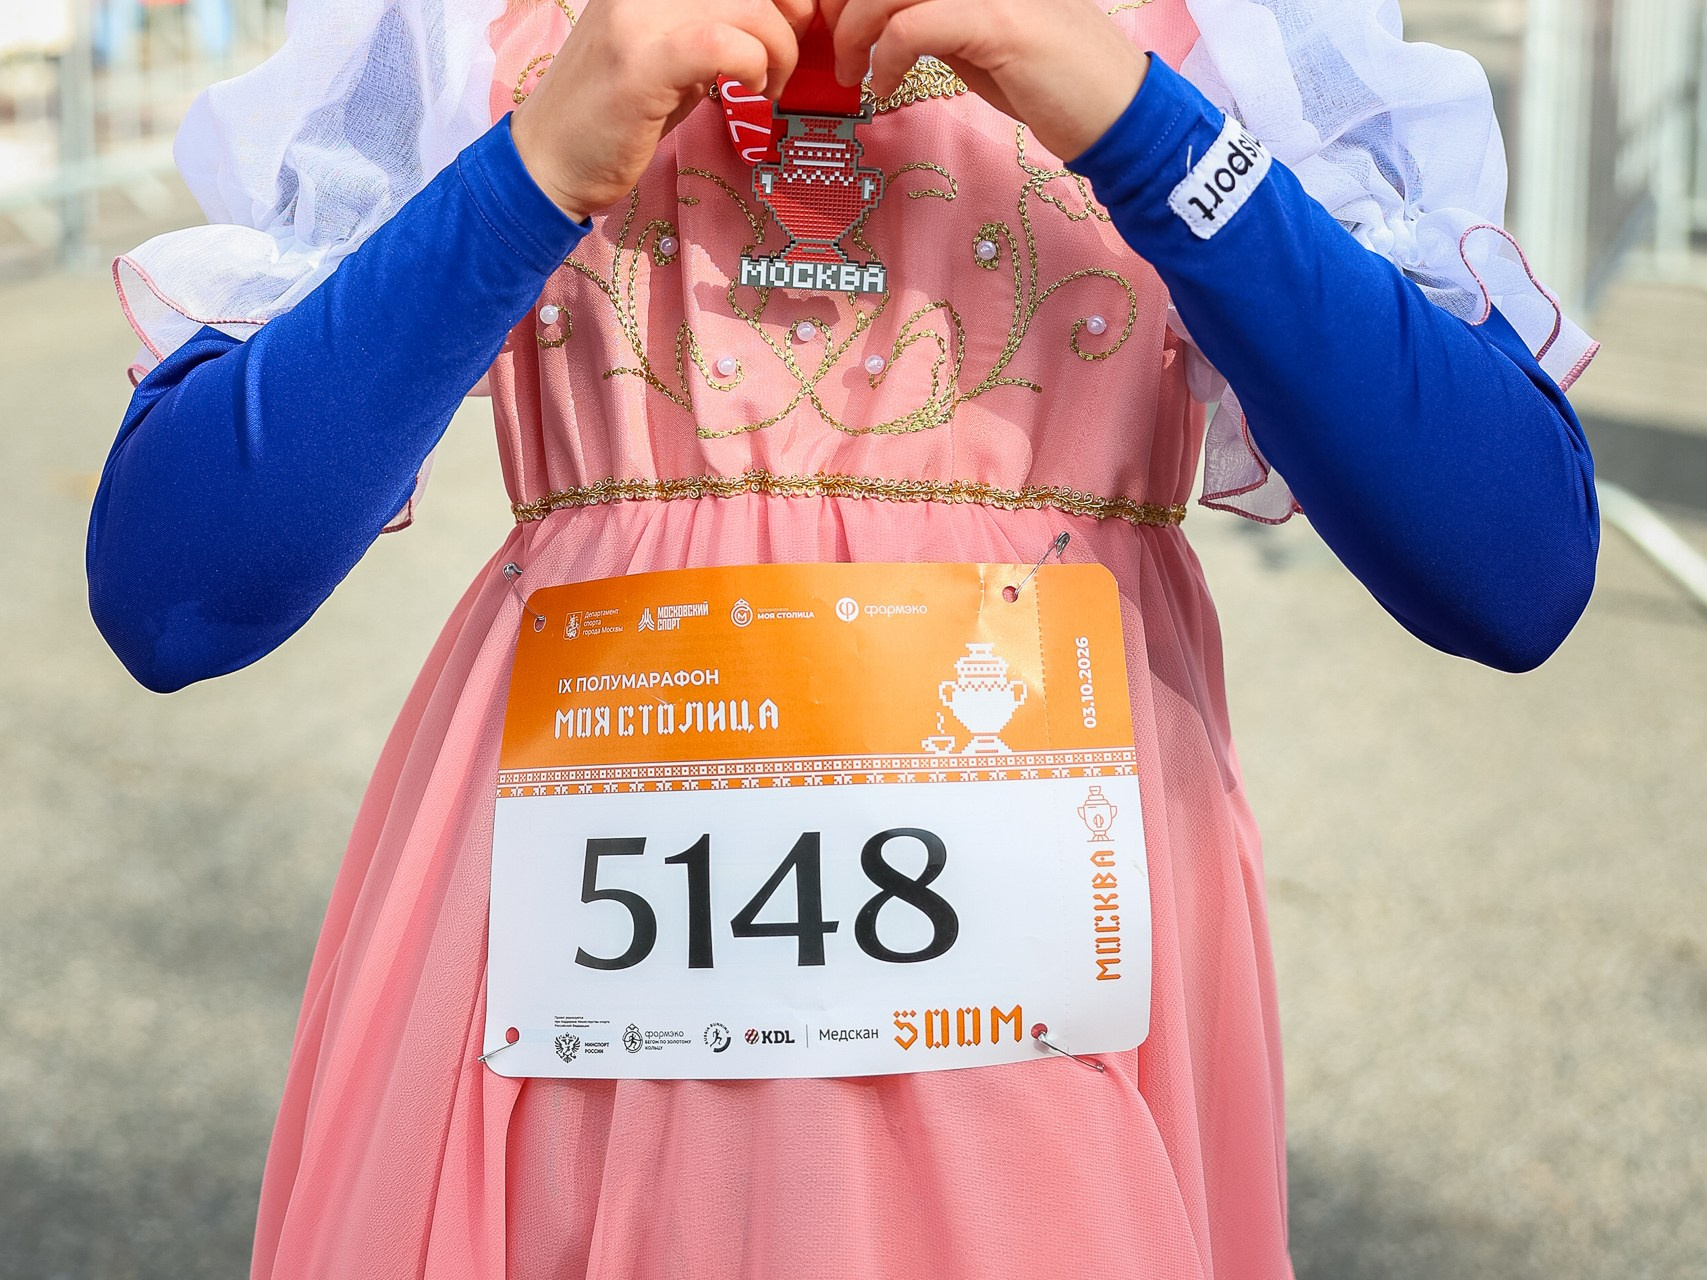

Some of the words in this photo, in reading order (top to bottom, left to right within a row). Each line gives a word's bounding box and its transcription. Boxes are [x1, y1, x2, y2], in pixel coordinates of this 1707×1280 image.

[1188, 139, 1258, 221] sport
[740, 260, 885, 292] МОСКВА
[585, 608, 619, 619] Департамент
[657, 601, 709, 618] МОСКОВСКИЙ
[776, 611, 815, 619] СТОЛИЦА
[864, 604, 928, 617] фармэко
[601, 626, 624, 634] Москвы
[657, 618, 681, 631] СПОРТ
[558, 679, 573, 694] IX
[576, 669, 719, 693] ПОЛУМАРАФОН
[1075, 636, 1097, 729] 03.10.2026
[554, 705, 610, 740] МОЯ
[618, 697, 779, 737] СТОЛИЦА
[574, 827, 960, 971] 5148
[1090, 850, 1122, 981] МОСКВА
[645, 1030, 684, 1039] фармэко
[761, 1030, 795, 1044] KDL
[819, 1028, 879, 1042] Медскан
